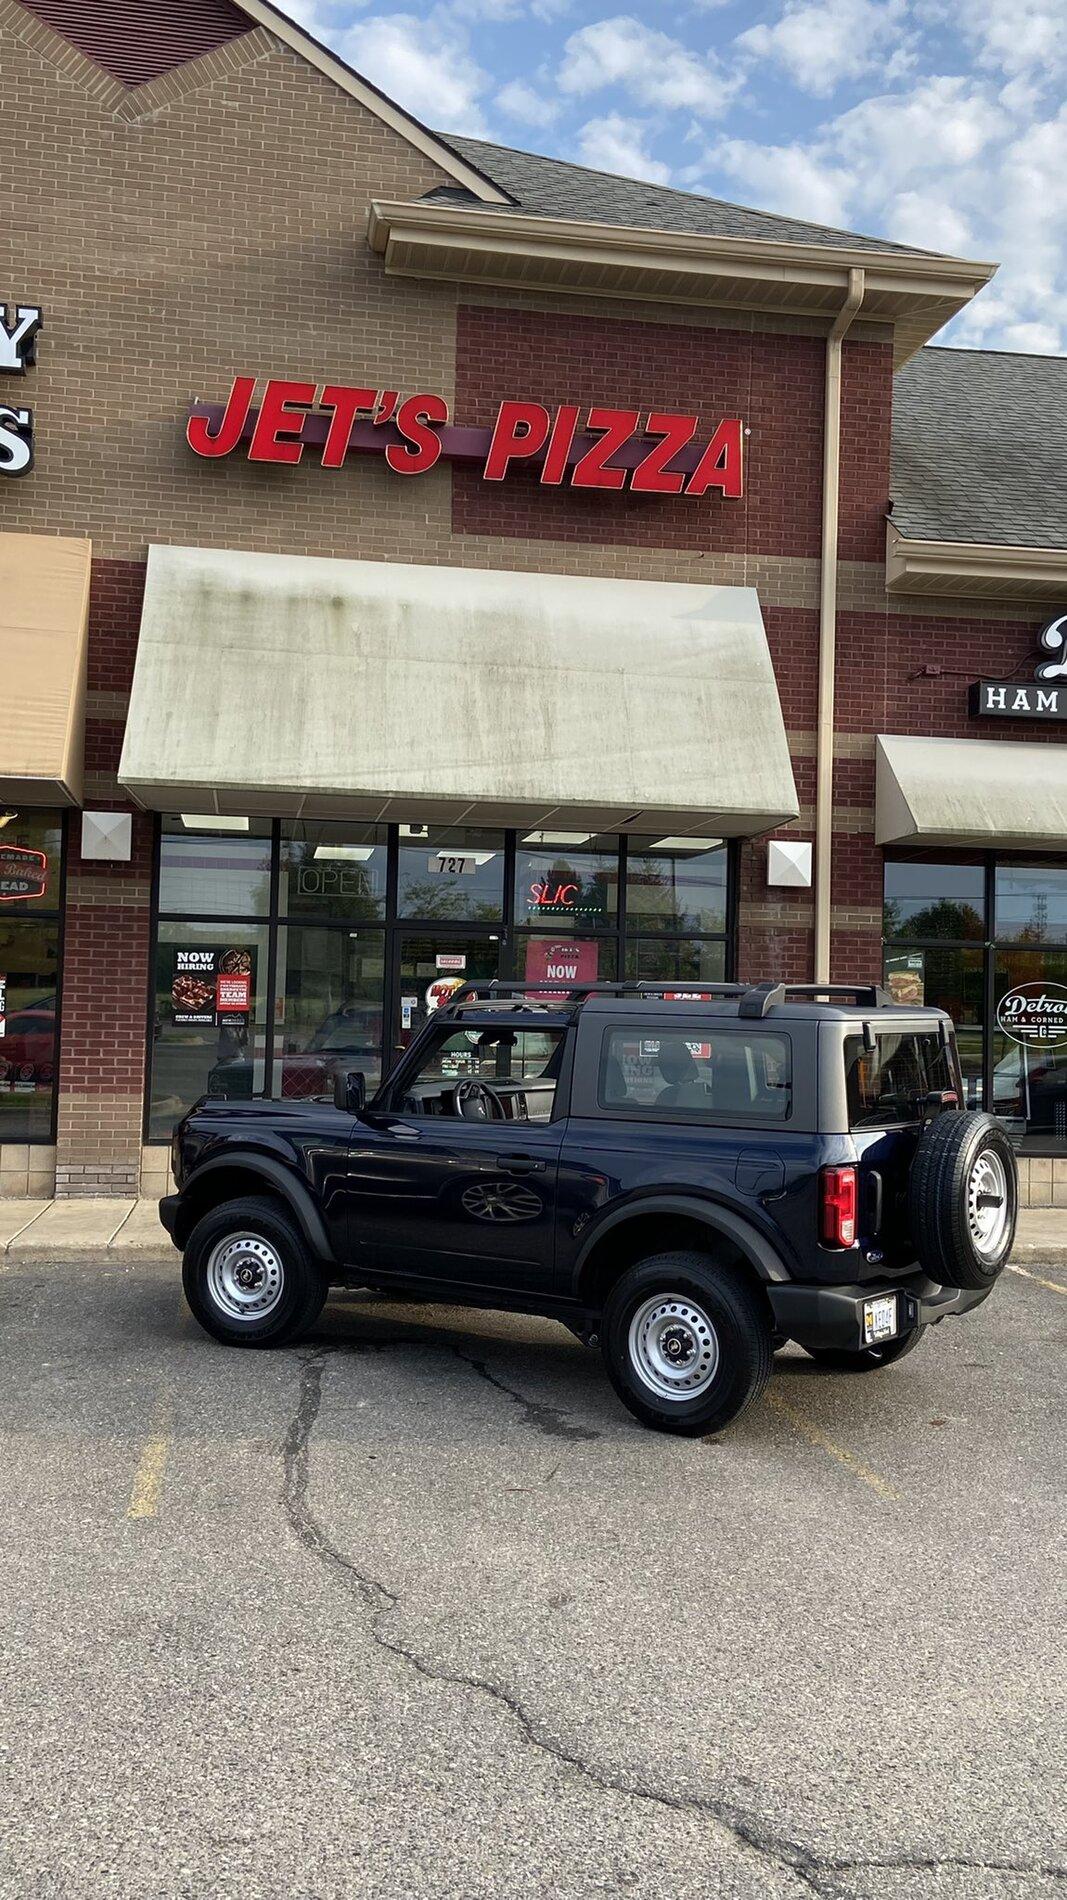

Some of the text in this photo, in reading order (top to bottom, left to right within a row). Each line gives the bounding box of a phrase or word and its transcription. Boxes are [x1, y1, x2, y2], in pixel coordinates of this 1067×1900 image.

[186, 376, 744, 498] JET'S PIZZA
[986, 686, 1059, 712] HAM
[4, 862, 47, 881] Baked
[438, 857, 466, 874] 727
[302, 869, 375, 896] OPEN
[177, 952, 215, 963] NOW
[177, 963, 214, 971] HIRING
[547, 965, 577, 979] NOW
